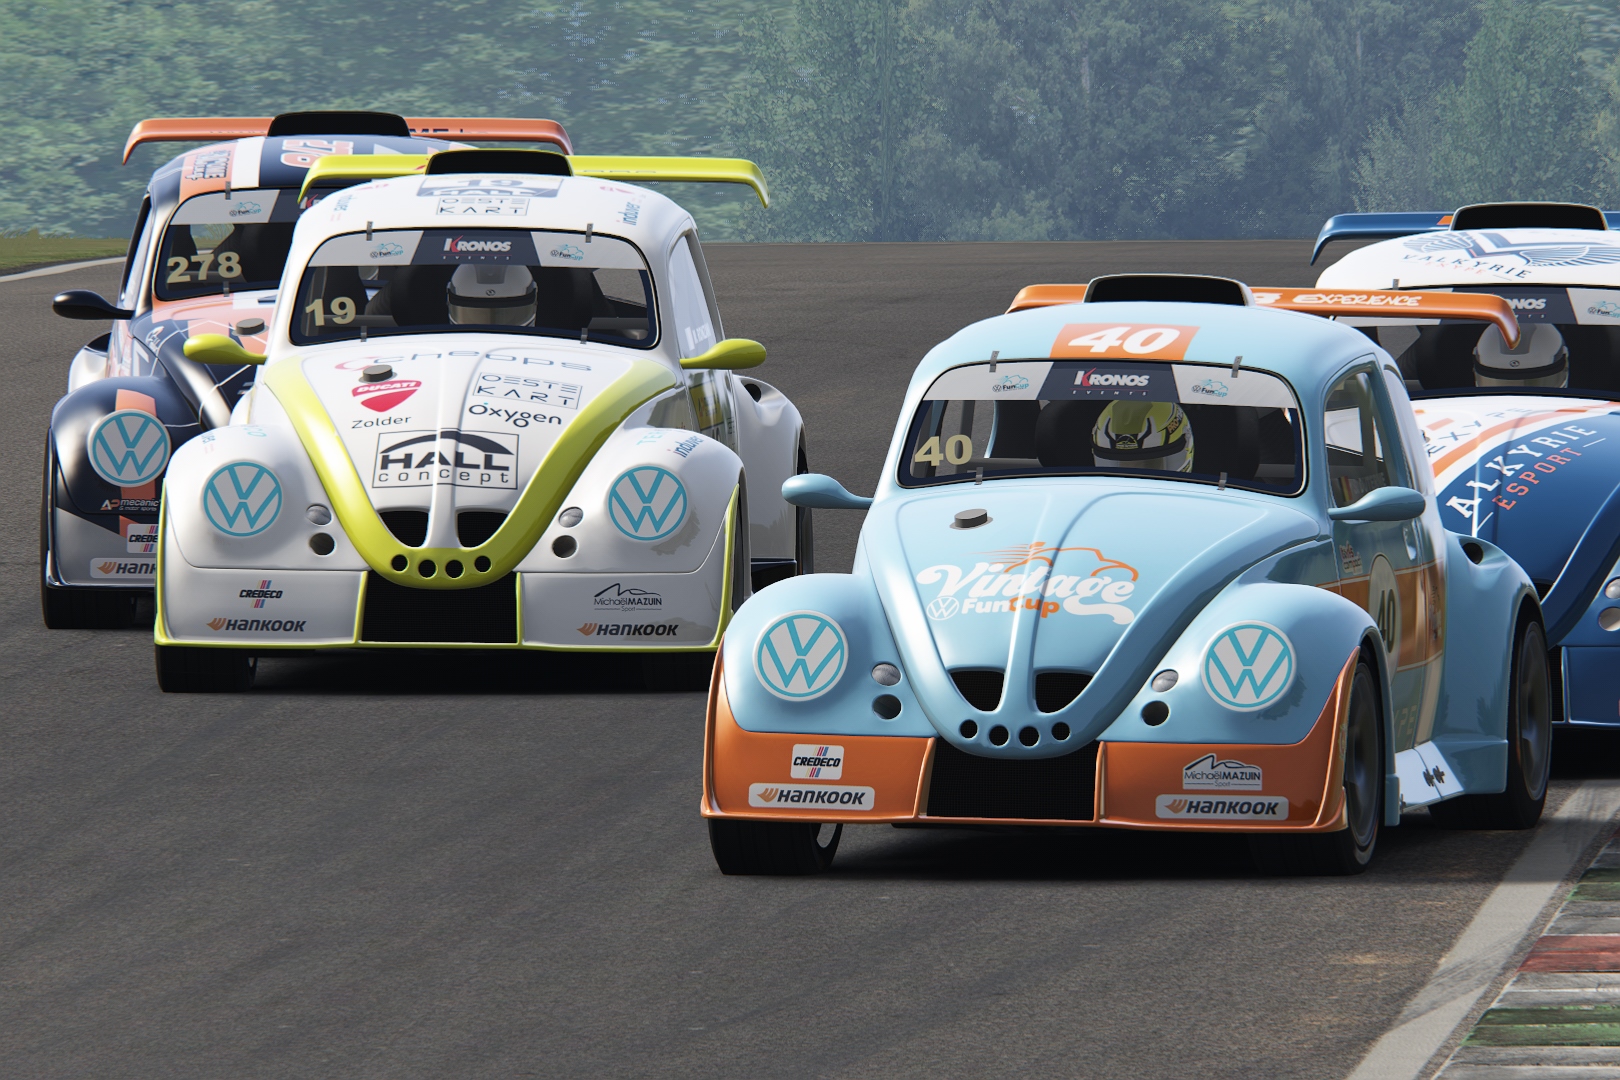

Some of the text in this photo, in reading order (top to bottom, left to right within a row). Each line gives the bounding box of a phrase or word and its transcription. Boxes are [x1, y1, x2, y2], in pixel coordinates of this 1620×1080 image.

[440, 206, 524, 214] KART
[443, 235, 513, 252] KRONOS
[166, 251, 243, 284] 278
[1403, 254, 1532, 279] VALKYRIE
[1292, 293, 1422, 307] EXPERIENCE
[305, 296, 357, 327] 19
[1068, 326, 1180, 354] 40
[357, 381, 417, 393] DUCATI
[482, 374, 578, 394] OESTE
[1074, 367, 1149, 387] KRONOS
[477, 385, 575, 406] KART
[351, 416, 412, 429] Zolder
[469, 403, 562, 428] Oxygen
[380, 450, 510, 471] HALL
[914, 434, 973, 467] 40
[378, 469, 509, 485] concept
[1445, 425, 1598, 519] ALKYRIE
[1491, 447, 1582, 511] ESPORT
[129, 534, 159, 543] CREDE
[239, 588, 283, 599] CREDECO
[916, 562, 1135, 625] Vintage
[1377, 588, 1397, 654] 40
[793, 756, 841, 768] CREDECO
